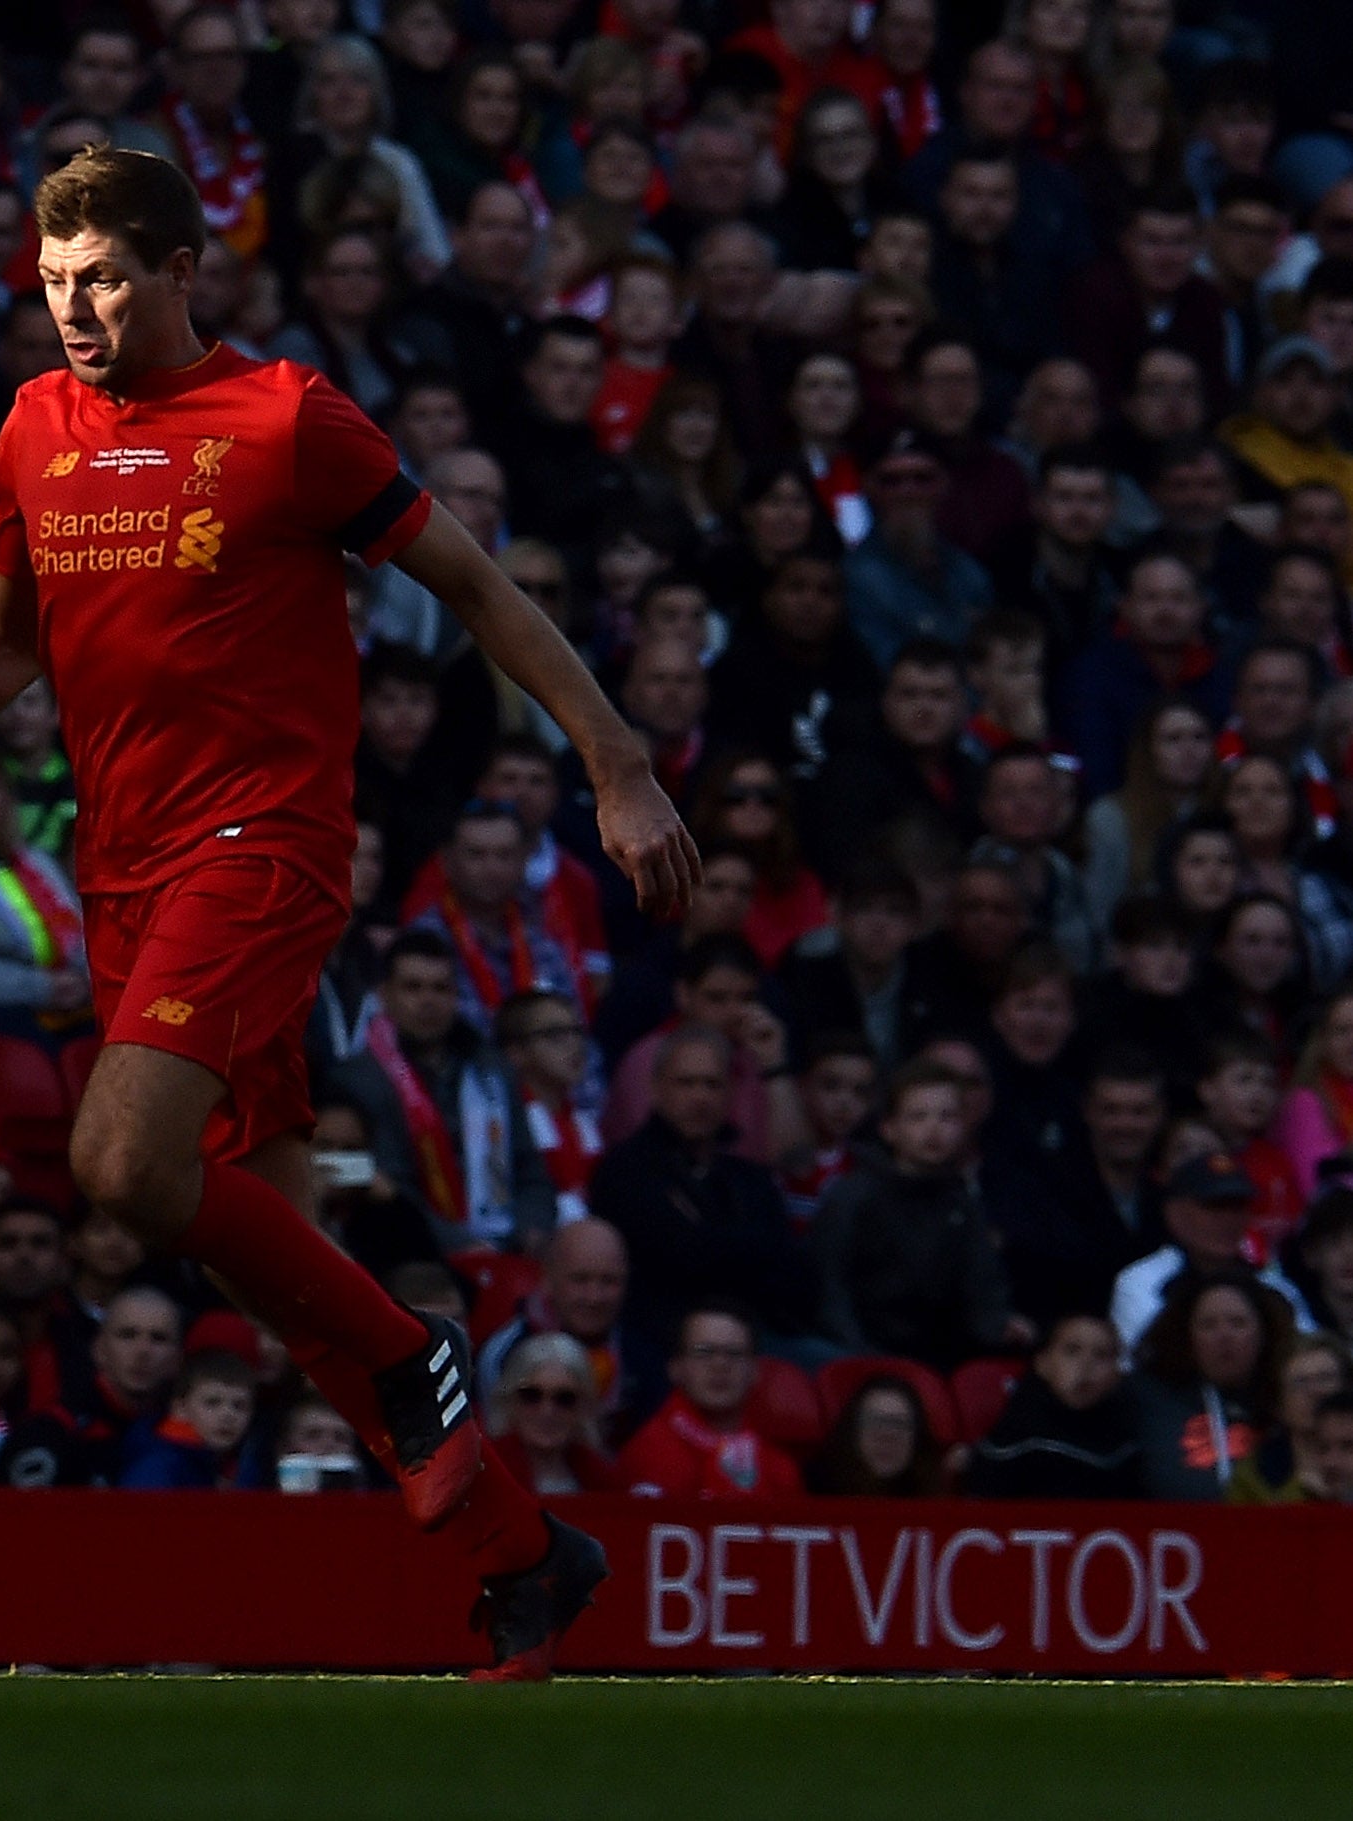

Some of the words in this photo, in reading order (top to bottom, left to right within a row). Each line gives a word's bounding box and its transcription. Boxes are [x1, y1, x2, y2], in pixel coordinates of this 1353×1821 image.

[181, 479, 220, 497] LFC
[39, 503, 170, 539] Standard
[32, 538, 166, 577] Chartered
